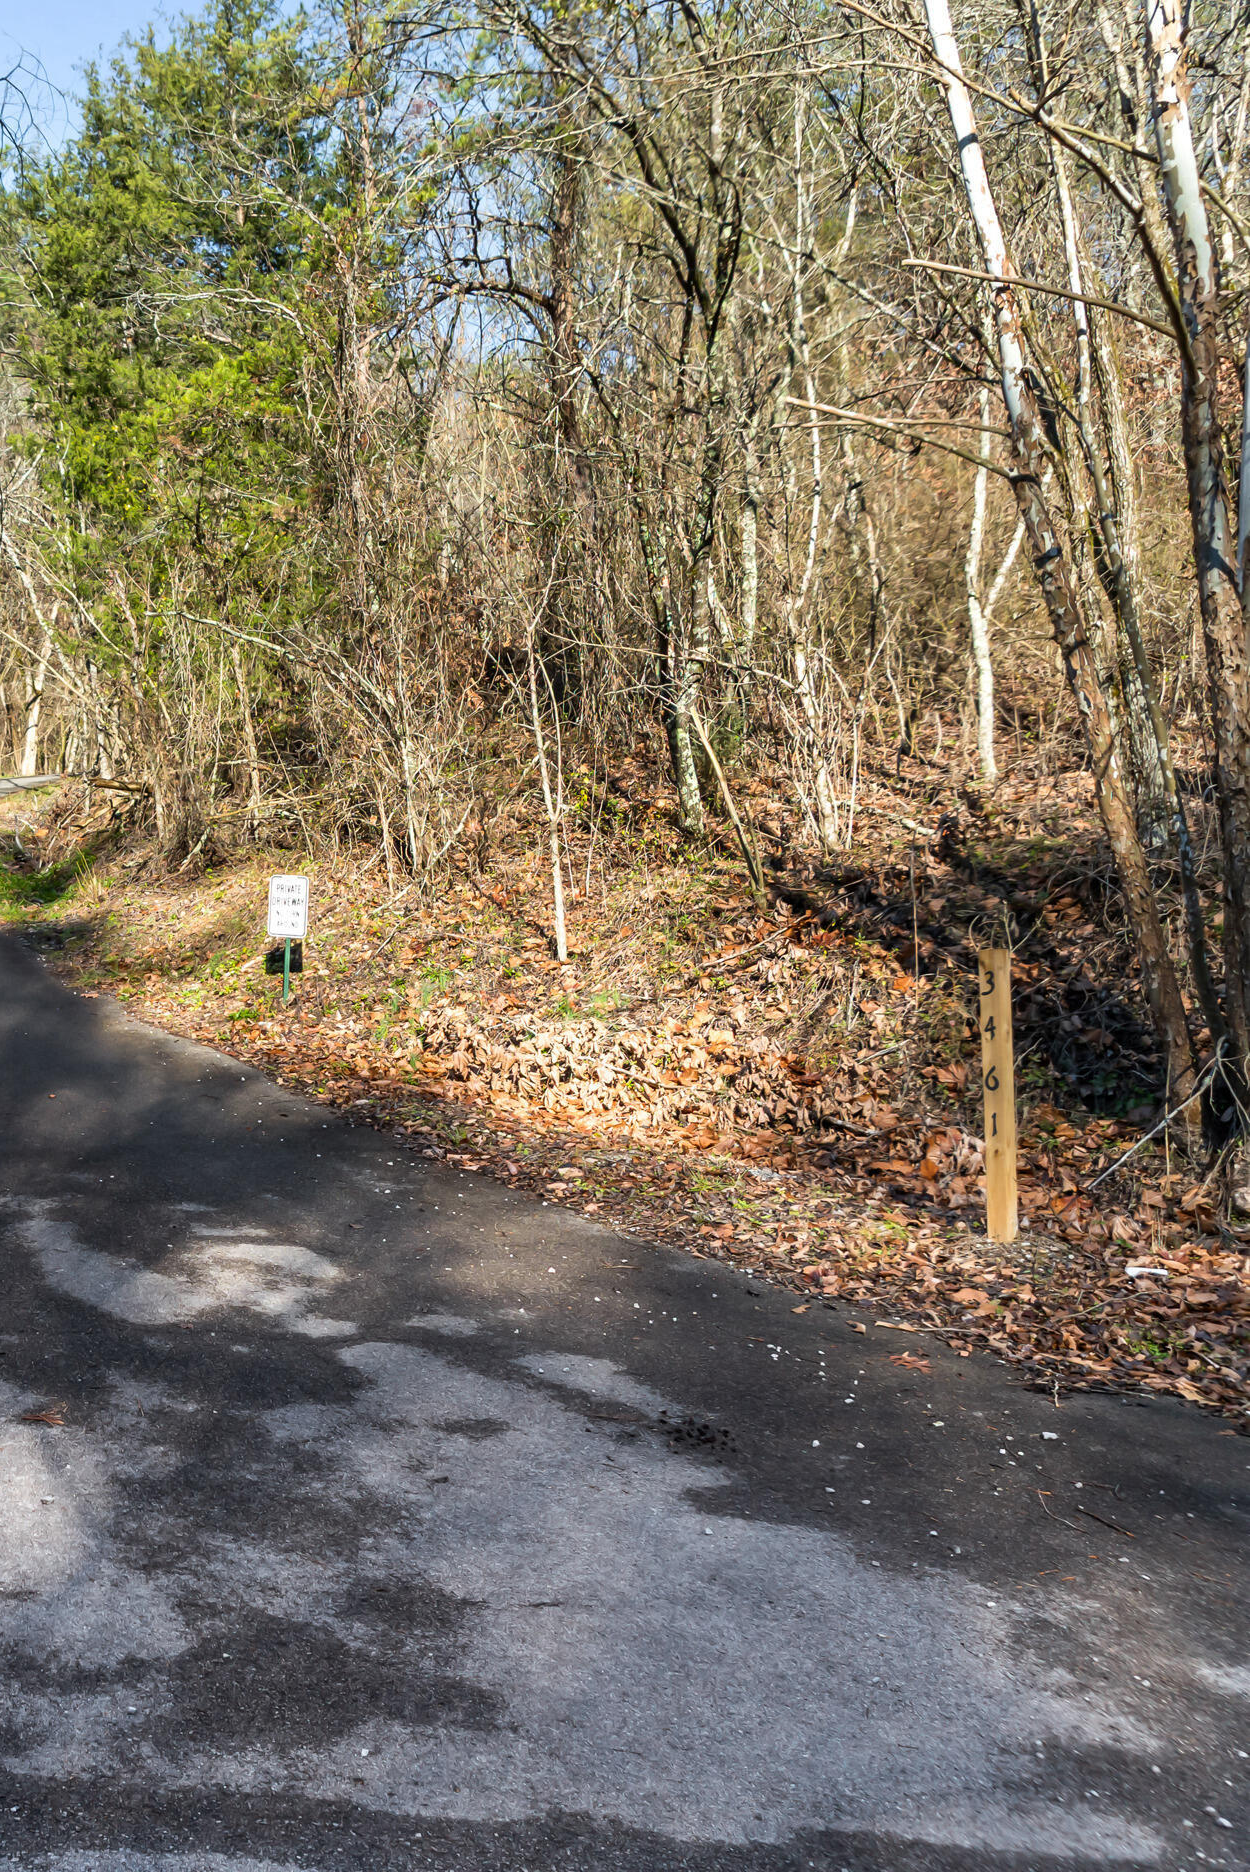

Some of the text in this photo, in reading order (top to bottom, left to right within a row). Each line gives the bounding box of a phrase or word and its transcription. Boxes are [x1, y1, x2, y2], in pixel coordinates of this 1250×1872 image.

[276, 884, 301, 894] PRIVATE
[272, 896, 304, 906] DRIVEWAY
[980, 970, 999, 1137] 3461
